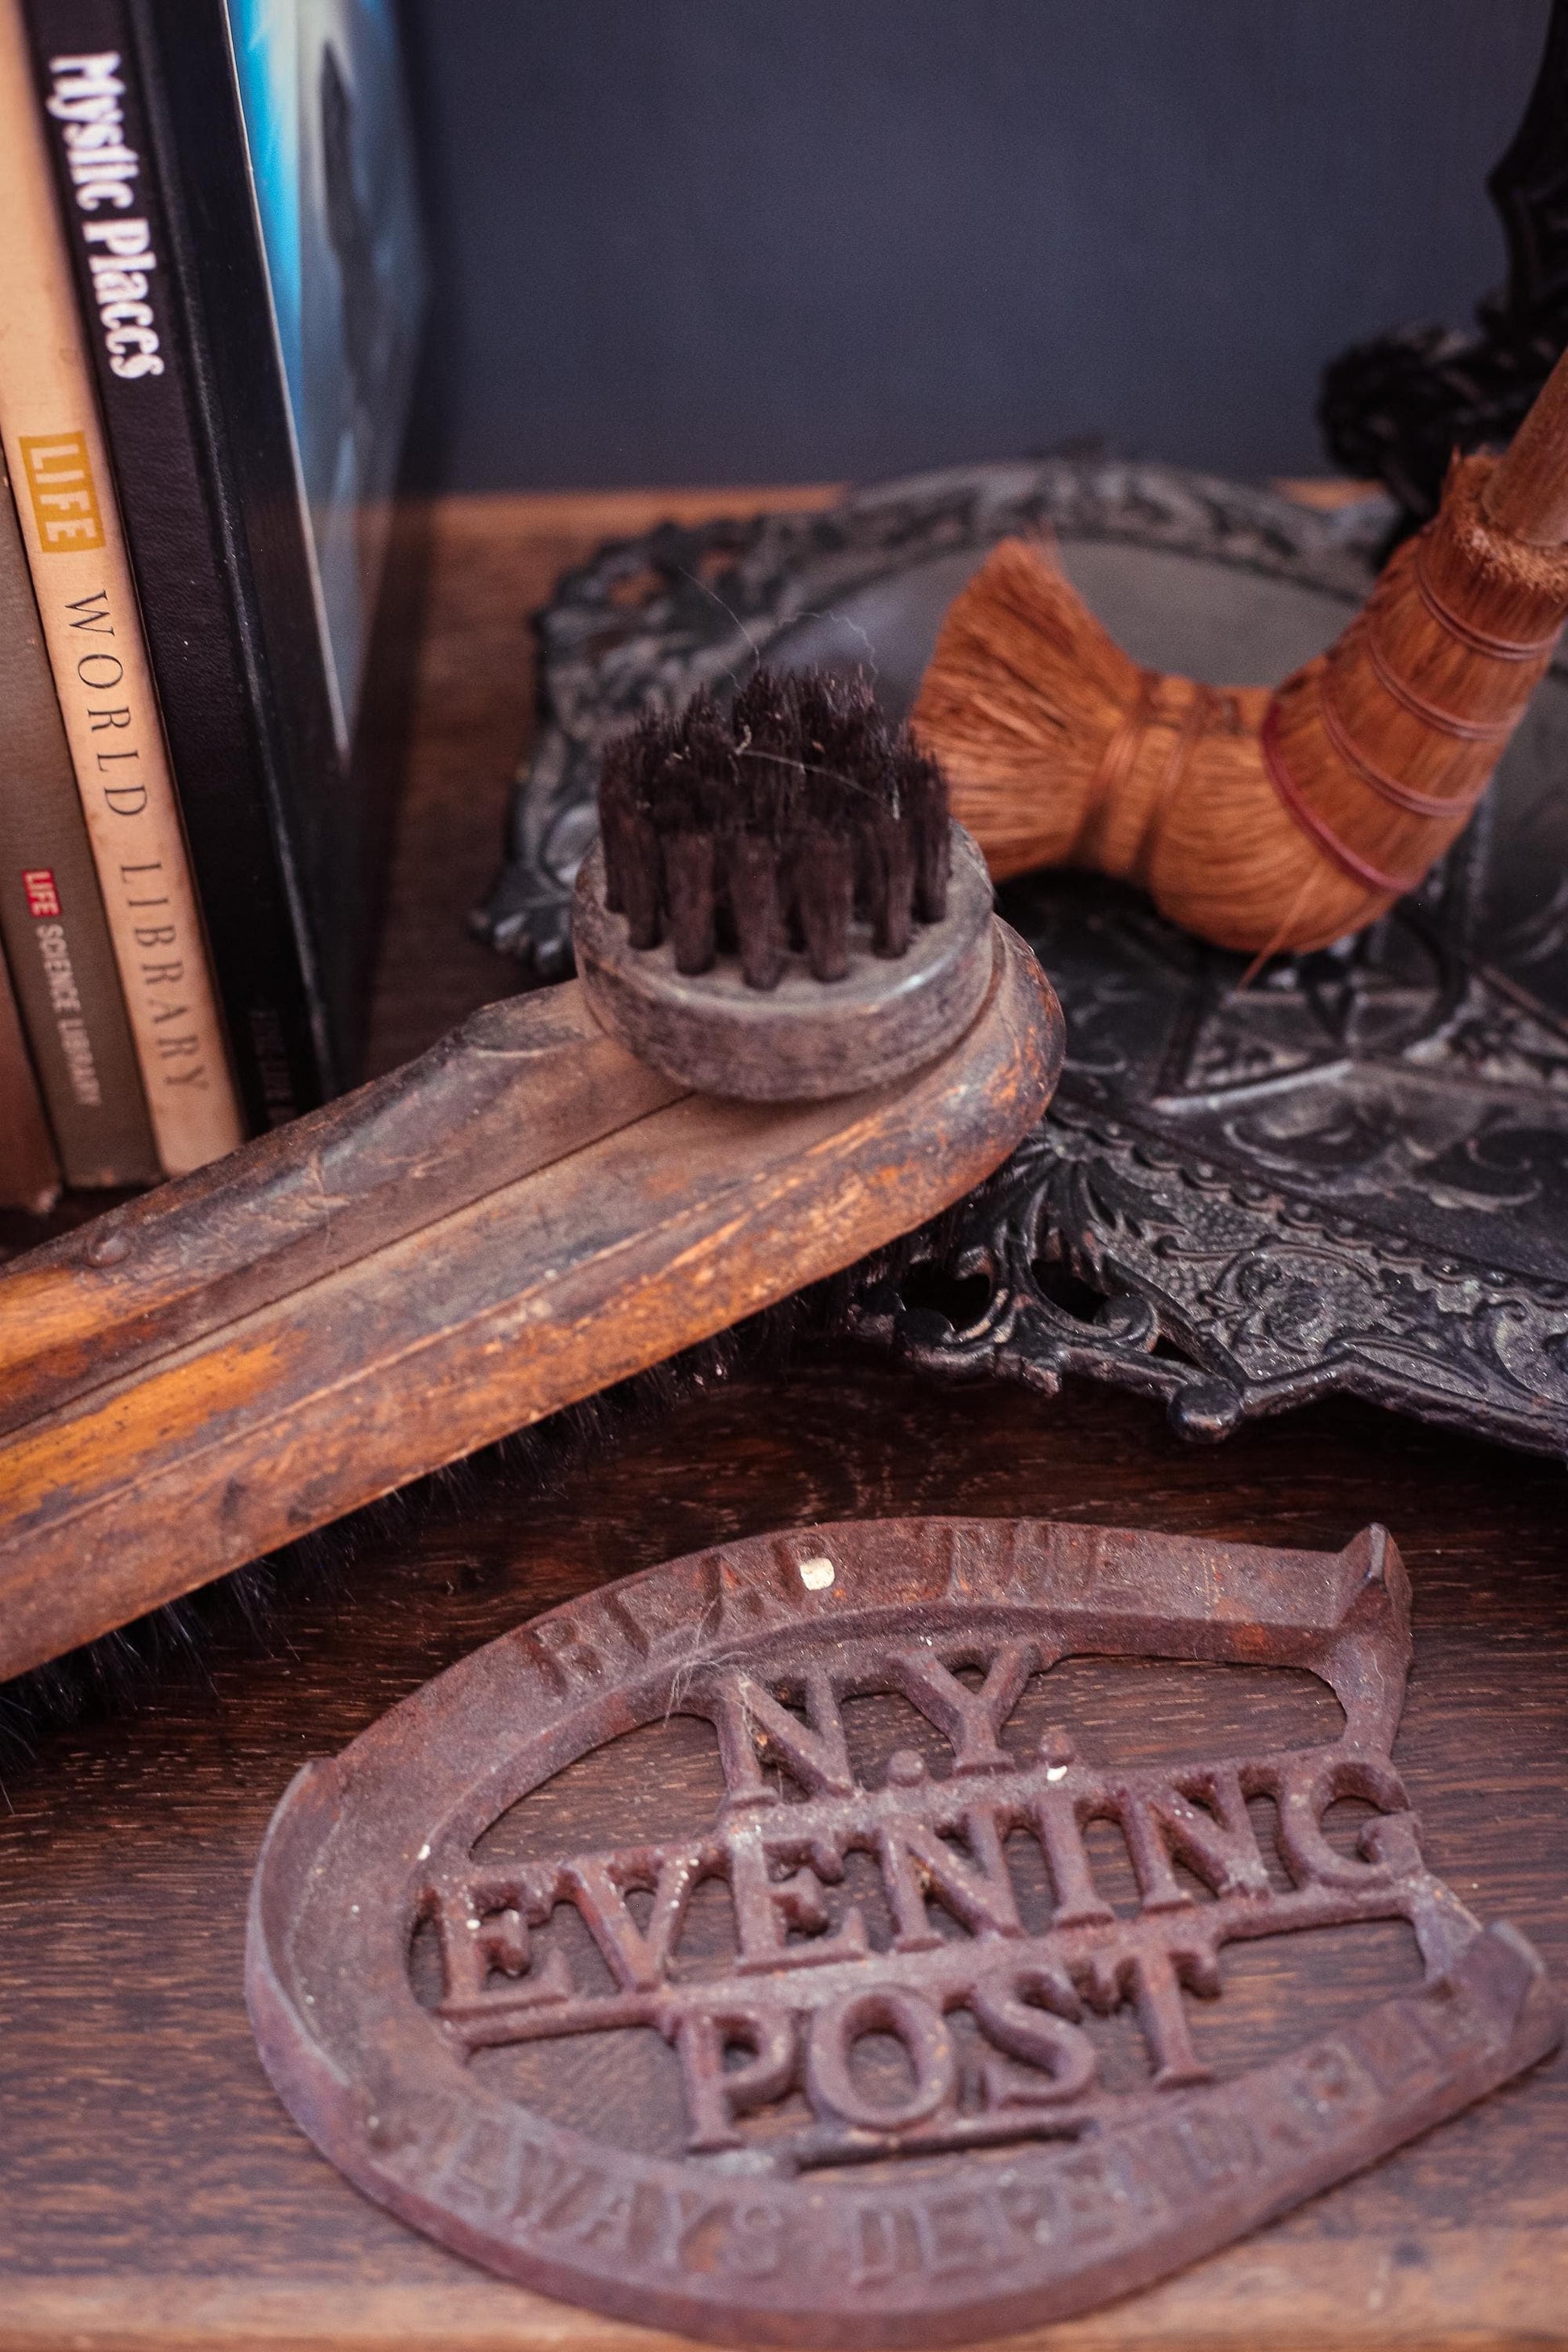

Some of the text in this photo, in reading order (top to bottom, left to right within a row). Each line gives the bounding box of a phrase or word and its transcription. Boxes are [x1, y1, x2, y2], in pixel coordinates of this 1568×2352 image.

[46, 51, 164, 379] Mystic Places
[29, 442, 209, 1091] LIFE WORLD LIBRARY
[24, 871, 60, 916] LIFE
[36, 923, 81, 1013] SCIENCE
[427, 1748, 1428, 2018] EVENING
[673, 1938, 1222, 2153] POST
